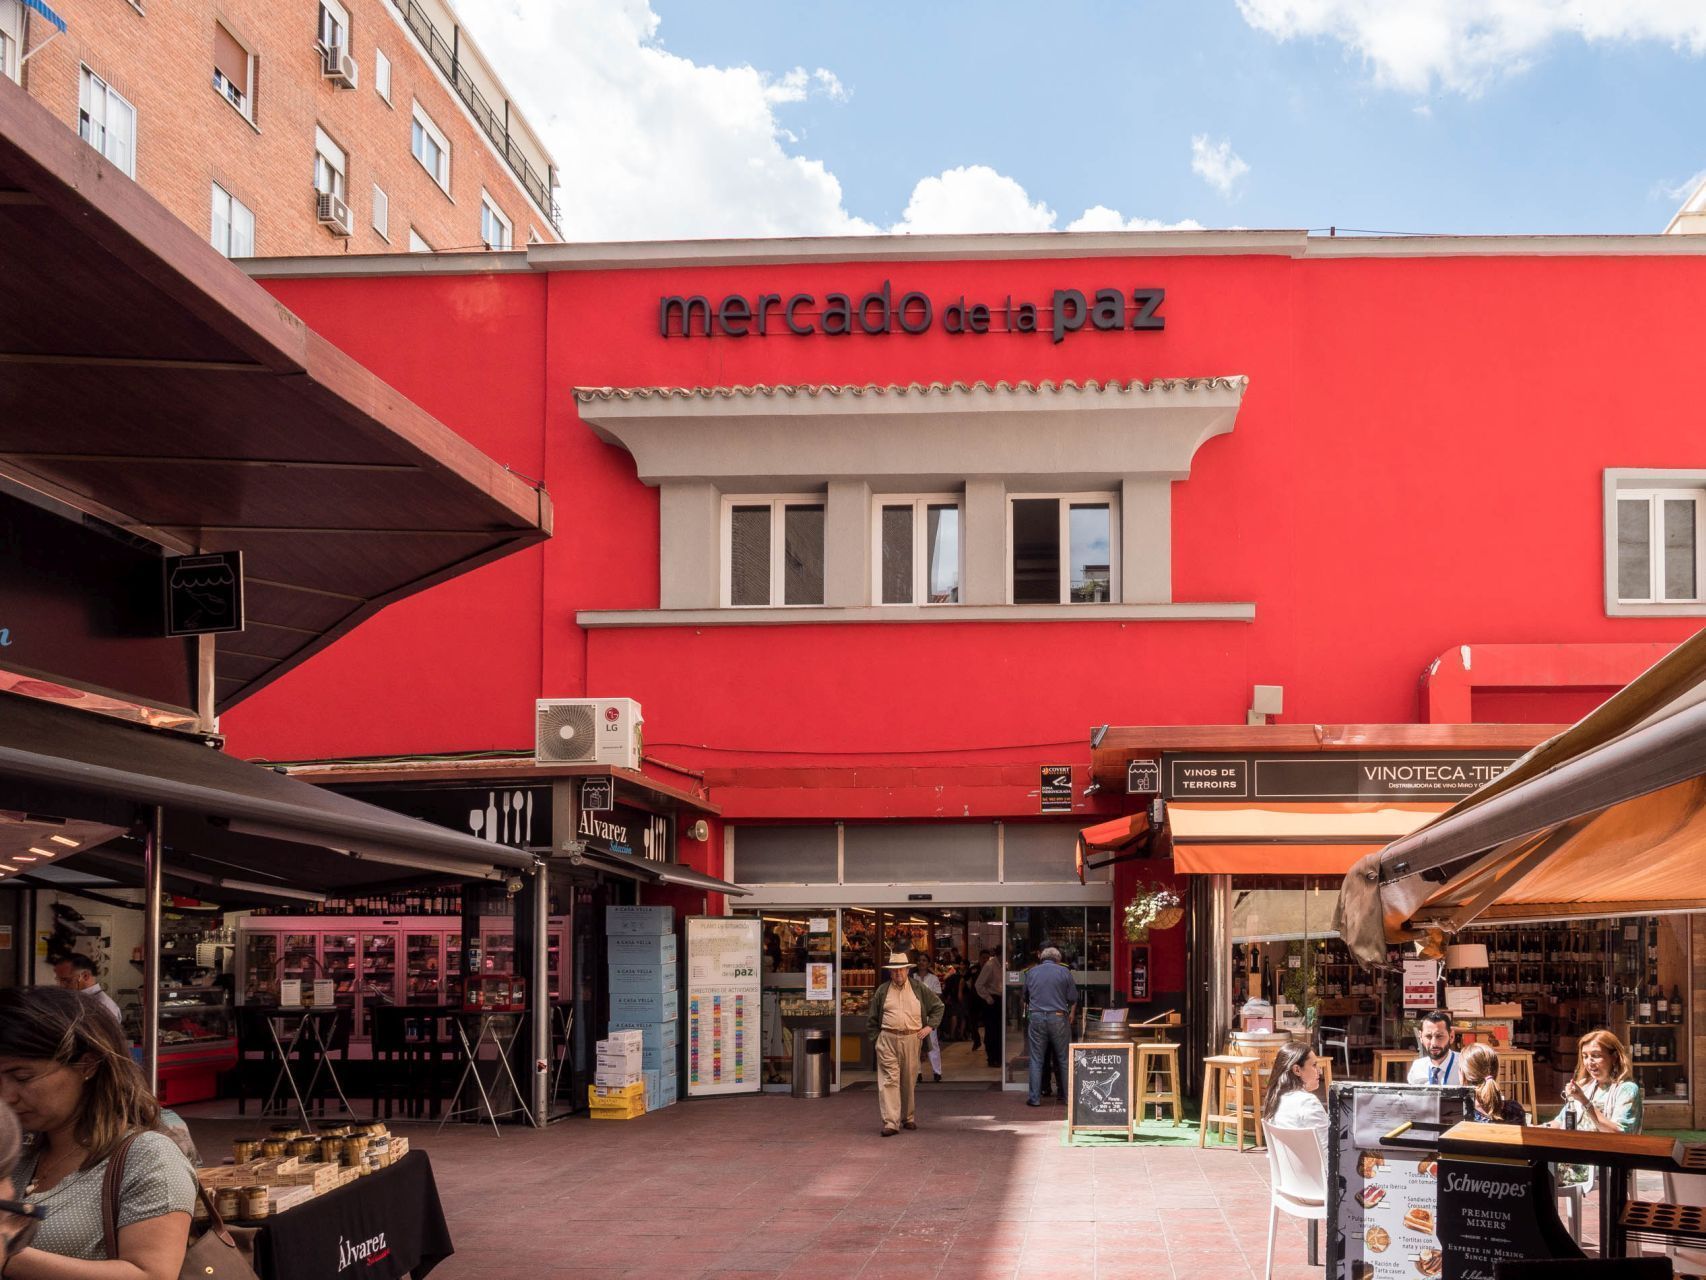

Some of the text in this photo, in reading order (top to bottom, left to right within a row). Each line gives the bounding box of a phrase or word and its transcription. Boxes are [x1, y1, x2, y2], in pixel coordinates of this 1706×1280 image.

[660, 279, 1166, 344] mercado de la paz
[606, 724, 618, 732] LG
[1364, 766, 1466, 780] VINOTECA
[735, 969, 753, 978] paz
[1444, 1172, 1527, 1199] Schweppes
[1462, 1208, 1511, 1220] PREMIUM
[1467, 1218, 1506, 1229] MIXERS
[338, 1232, 386, 1272] Álvarez
[1465, 1253, 1487, 1262] SINCE
[1495, 1249, 1524, 1258] MIXING
